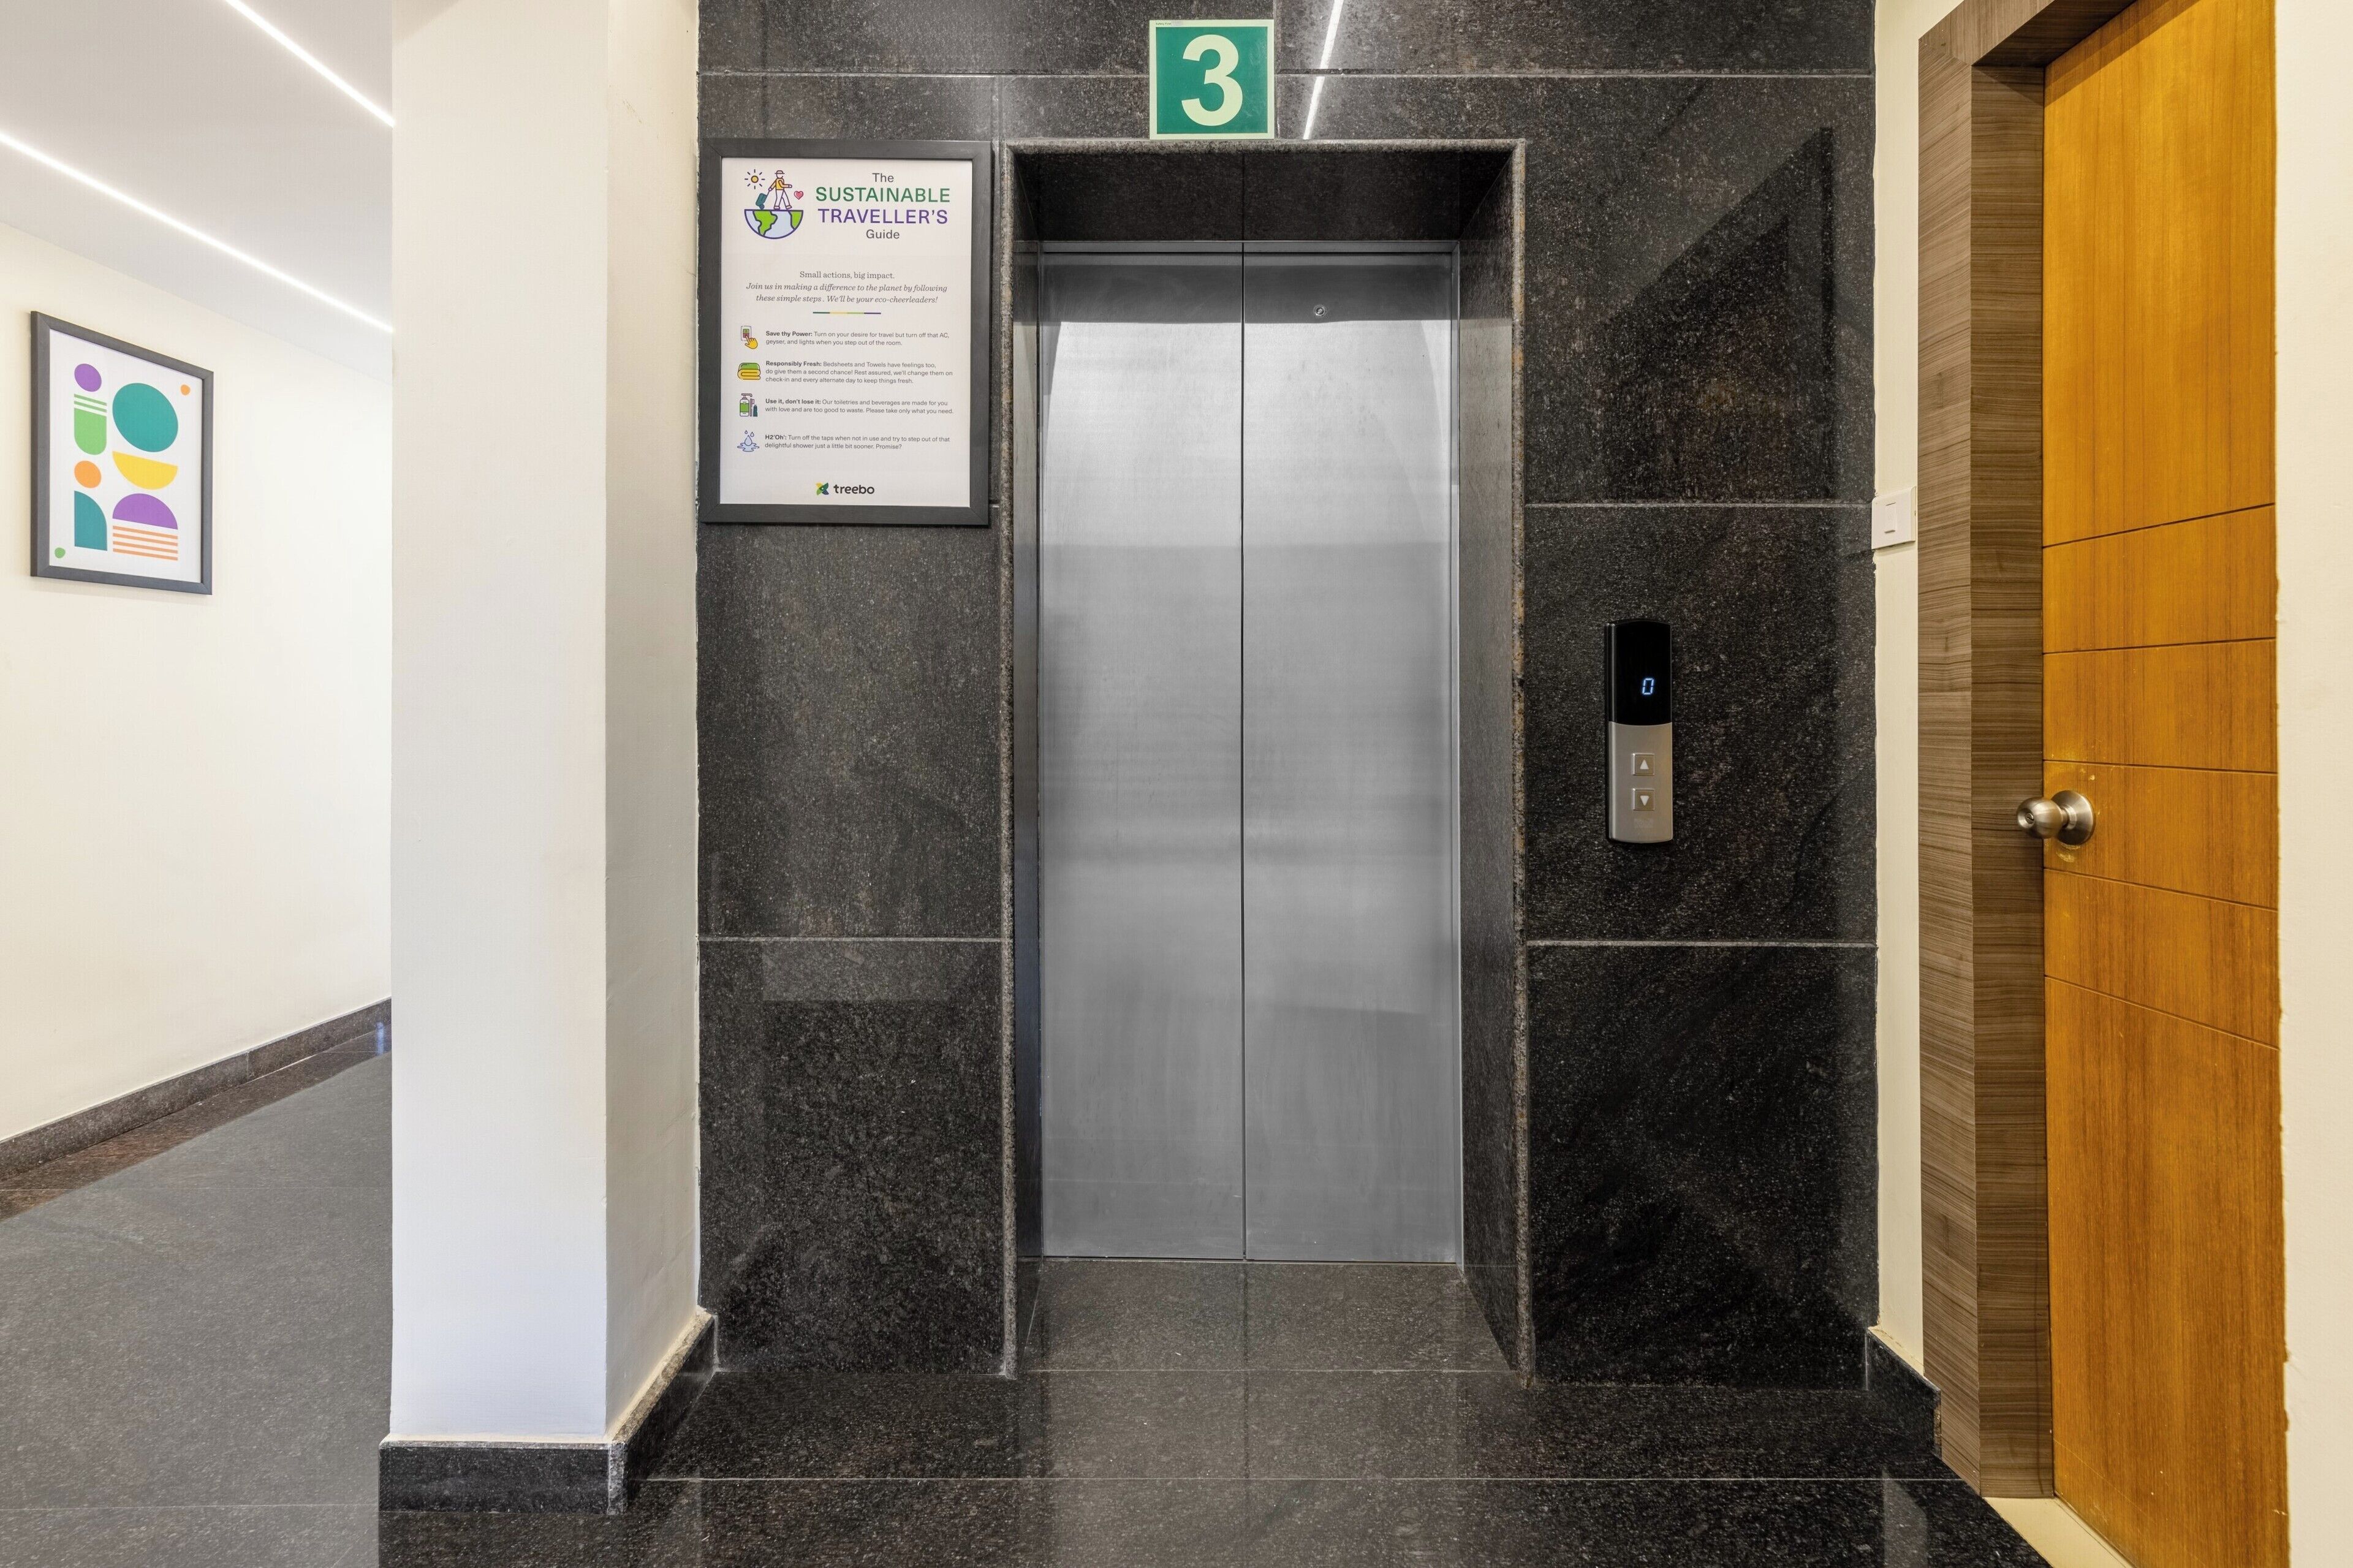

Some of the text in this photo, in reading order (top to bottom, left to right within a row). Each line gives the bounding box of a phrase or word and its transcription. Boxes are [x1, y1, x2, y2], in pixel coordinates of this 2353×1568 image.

[1181, 34, 1243, 126] 3
[872, 173, 894, 182] The
[816, 186, 950, 202] SUSTAINABLE
[817, 208, 947, 224] TRAVELLER'S
[866, 229, 900, 239] Guide
[819, 283, 855, 292] difference
[833, 484, 874, 494] treebo
[1641, 678, 1655, 695] 0
